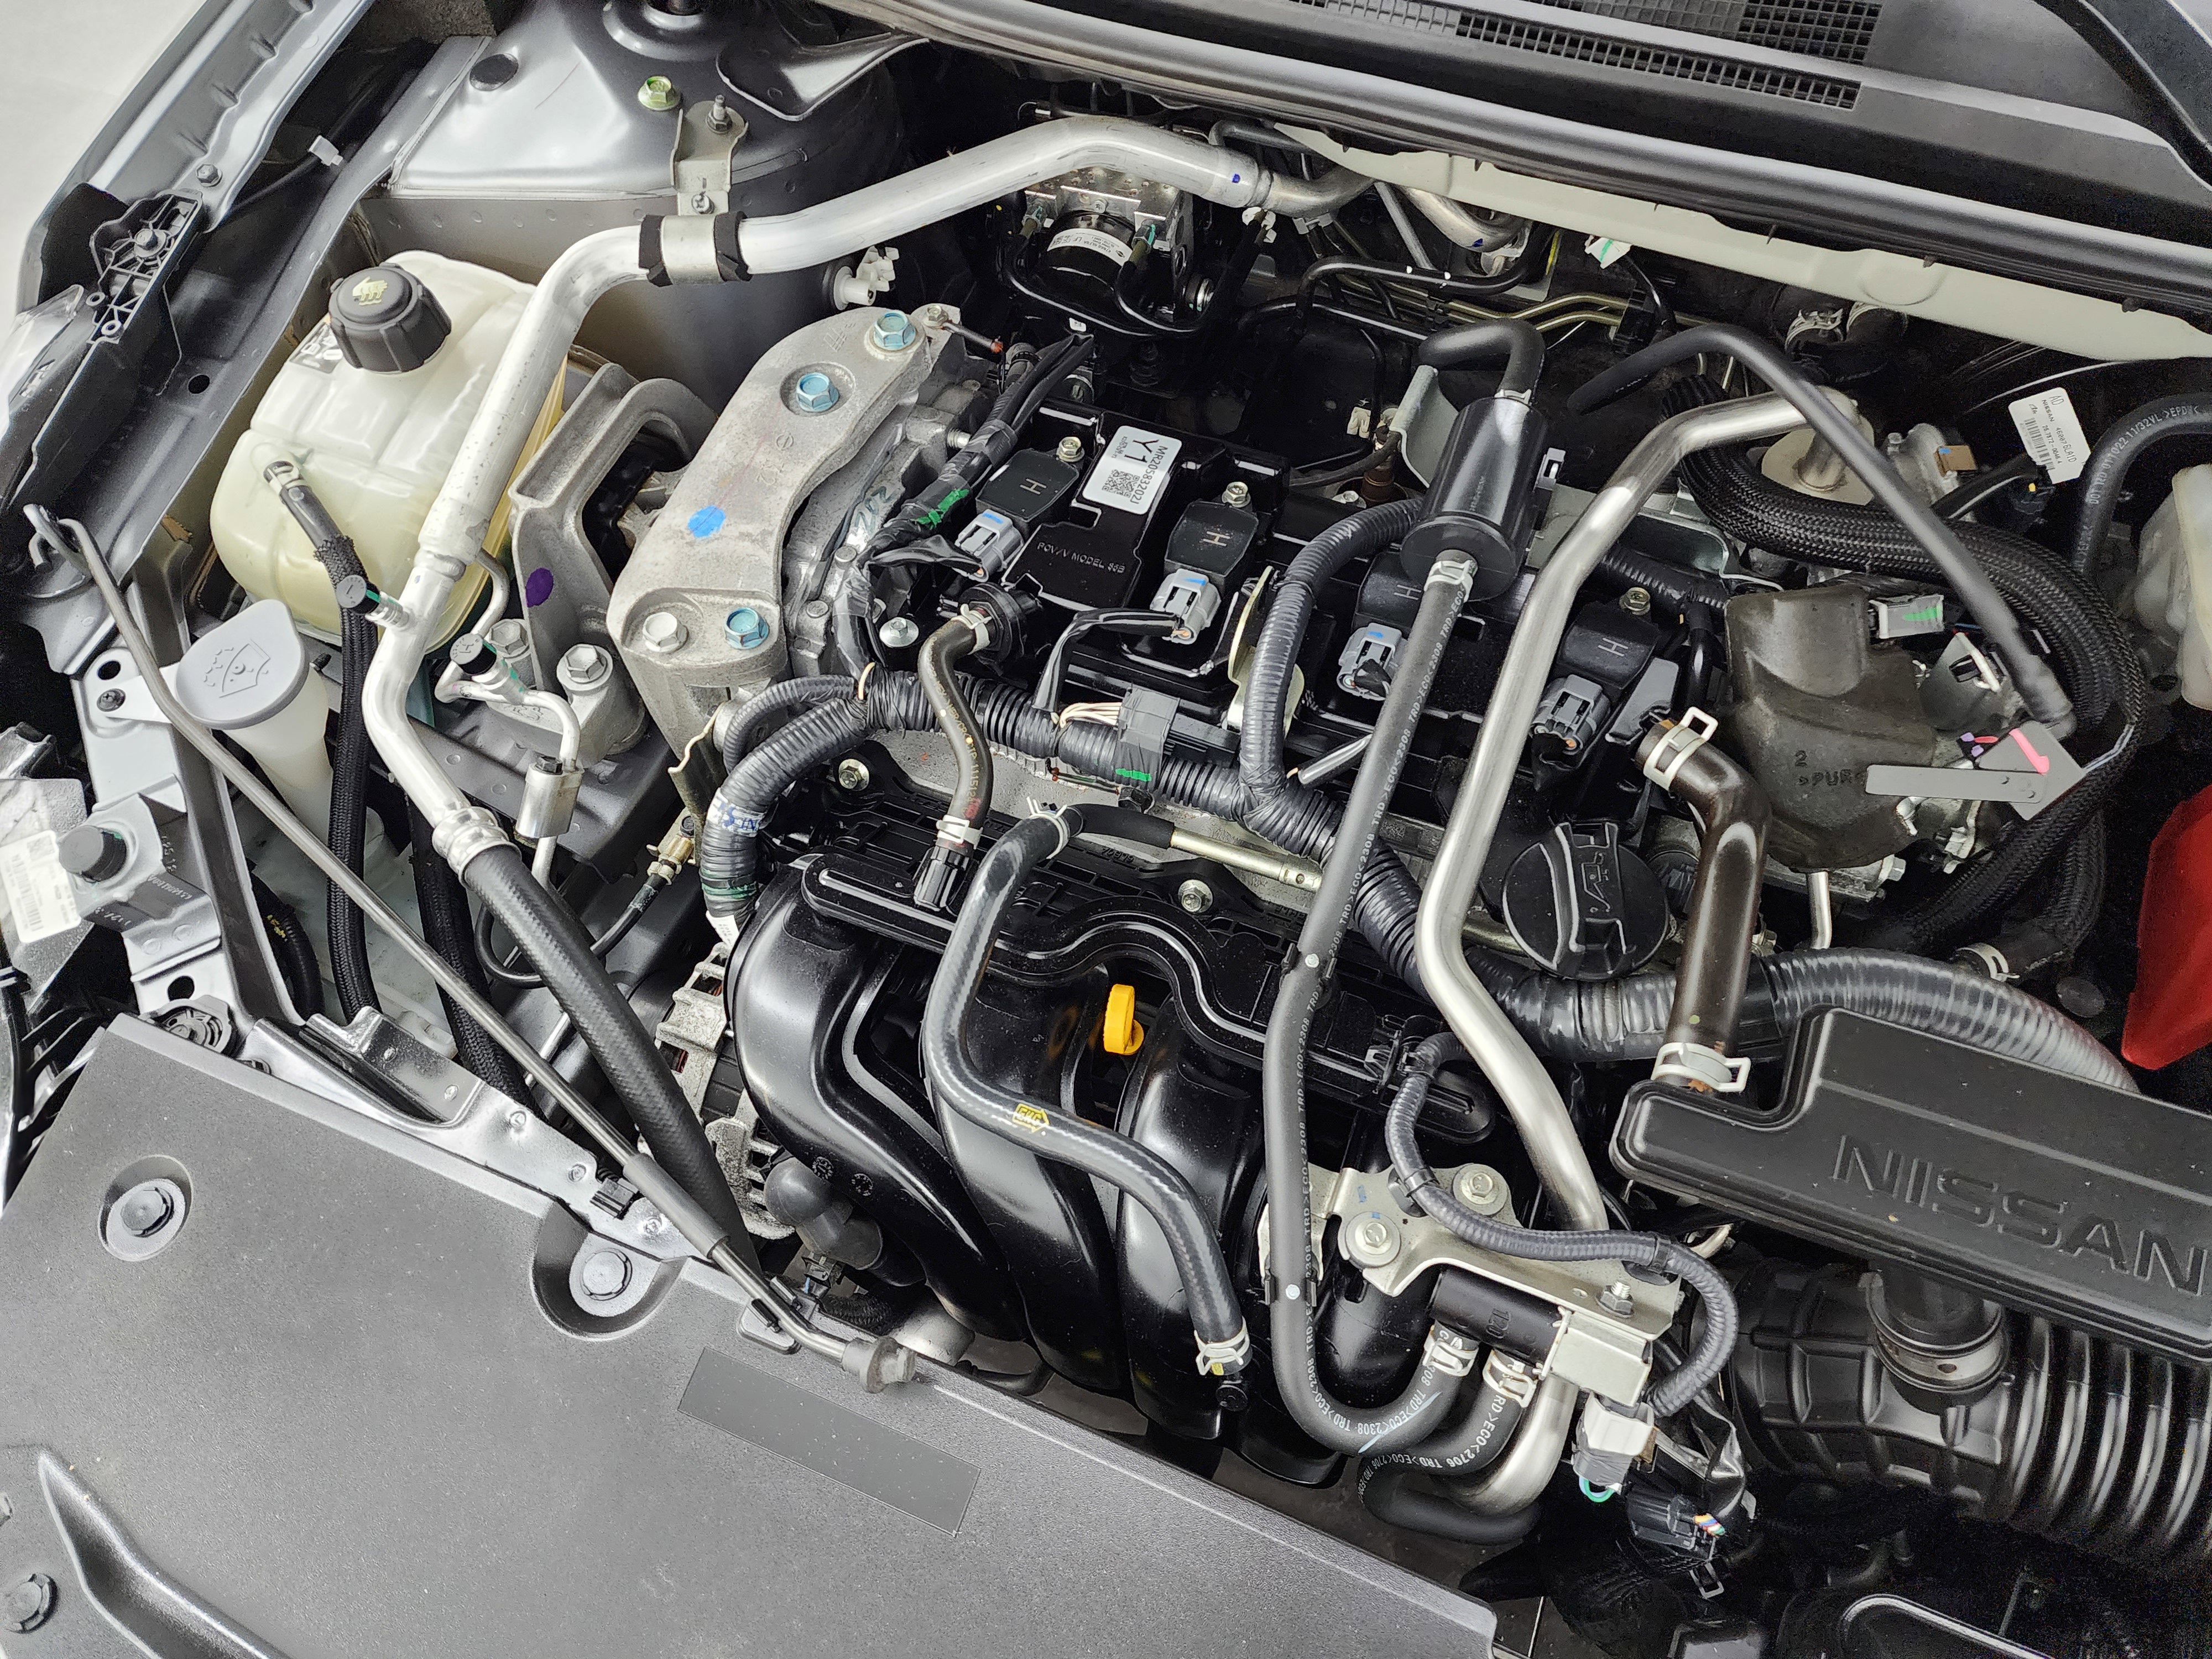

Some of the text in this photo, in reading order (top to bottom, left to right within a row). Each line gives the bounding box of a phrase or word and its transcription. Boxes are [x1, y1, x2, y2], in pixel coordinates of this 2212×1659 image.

[2042, 399, 2055, 422] NISSAN
[2049, 395, 2064, 405] AD
[1124, 439, 1160, 463] Y1
[1130, 445, 1168, 504] MR20583202J
[1071, 552, 1104, 569] MODEL
[1794, 749, 1808, 767] 2
[1832, 1135, 2211, 1296] NISSAN
